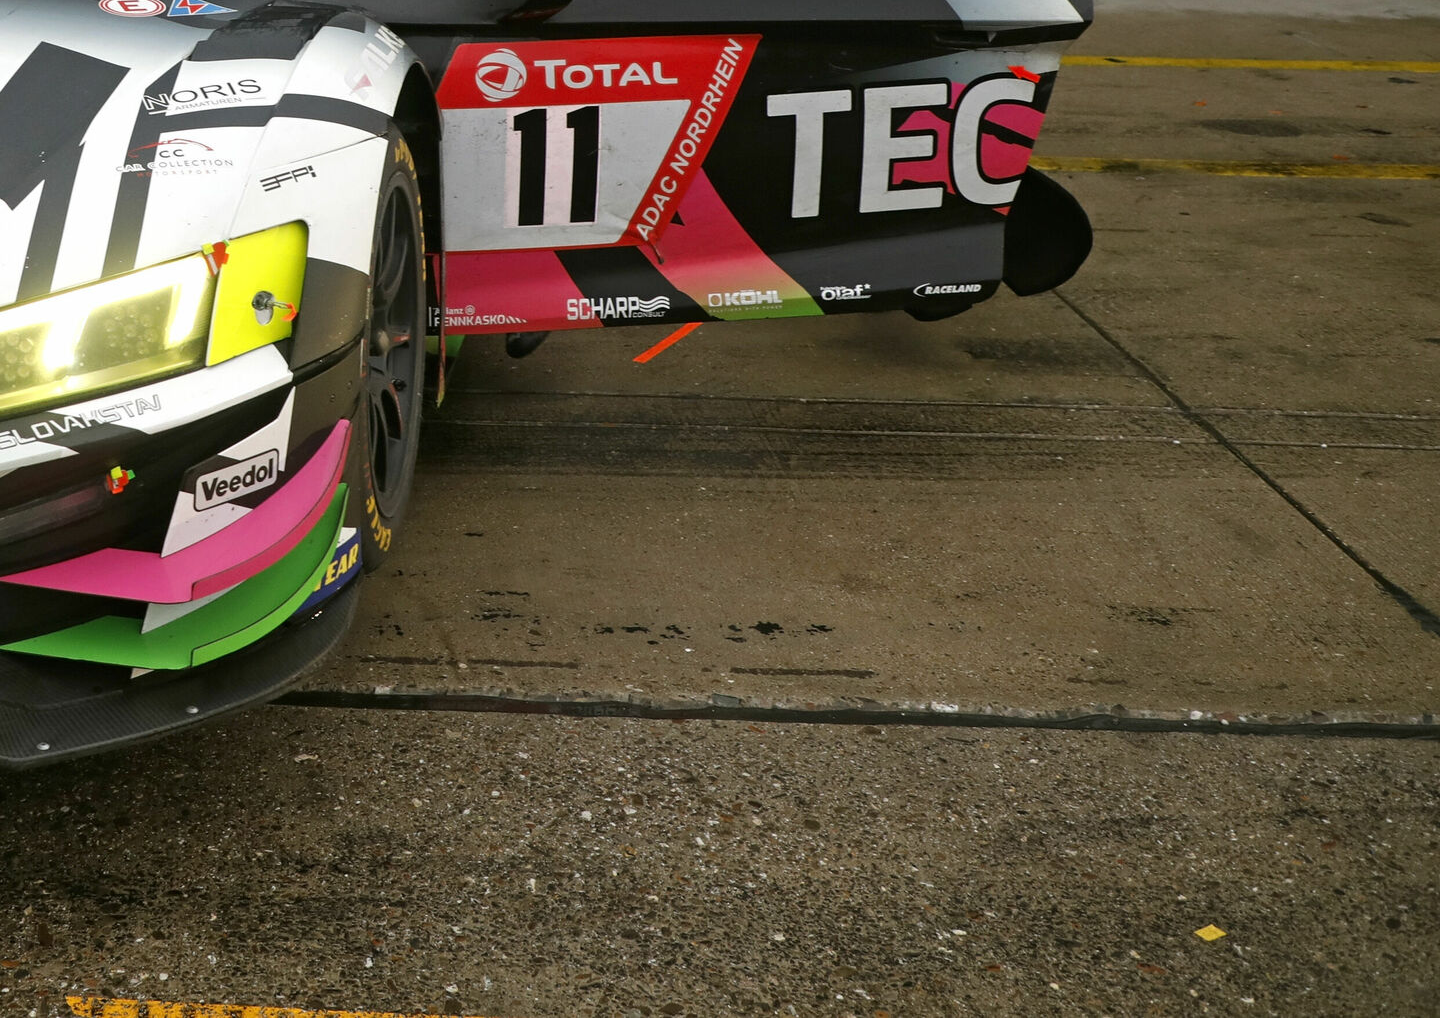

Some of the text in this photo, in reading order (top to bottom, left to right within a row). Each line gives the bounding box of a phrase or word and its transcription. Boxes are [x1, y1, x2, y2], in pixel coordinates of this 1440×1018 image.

[534, 58, 679, 90] TOTAL
[143, 79, 263, 112] NORIS
[173, 96, 243, 112] ARMATUREN
[635, 37, 745, 243] ADAC NORDRHEIN
[766, 77, 1037, 219] TEC
[158, 148, 186, 158] CC
[114, 159, 235, 174] CAR COLLECTION
[135, 169, 220, 179] MOTORSPORT
[513, 105, 601, 227] 11
[725, 289, 784, 307] KÖHL
[924, 283, 982, 296] RACELAND
[566, 296, 640, 321] SCHARP
[631, 309, 665, 318] CONSULT
[201, 457, 275, 502] Veedol
